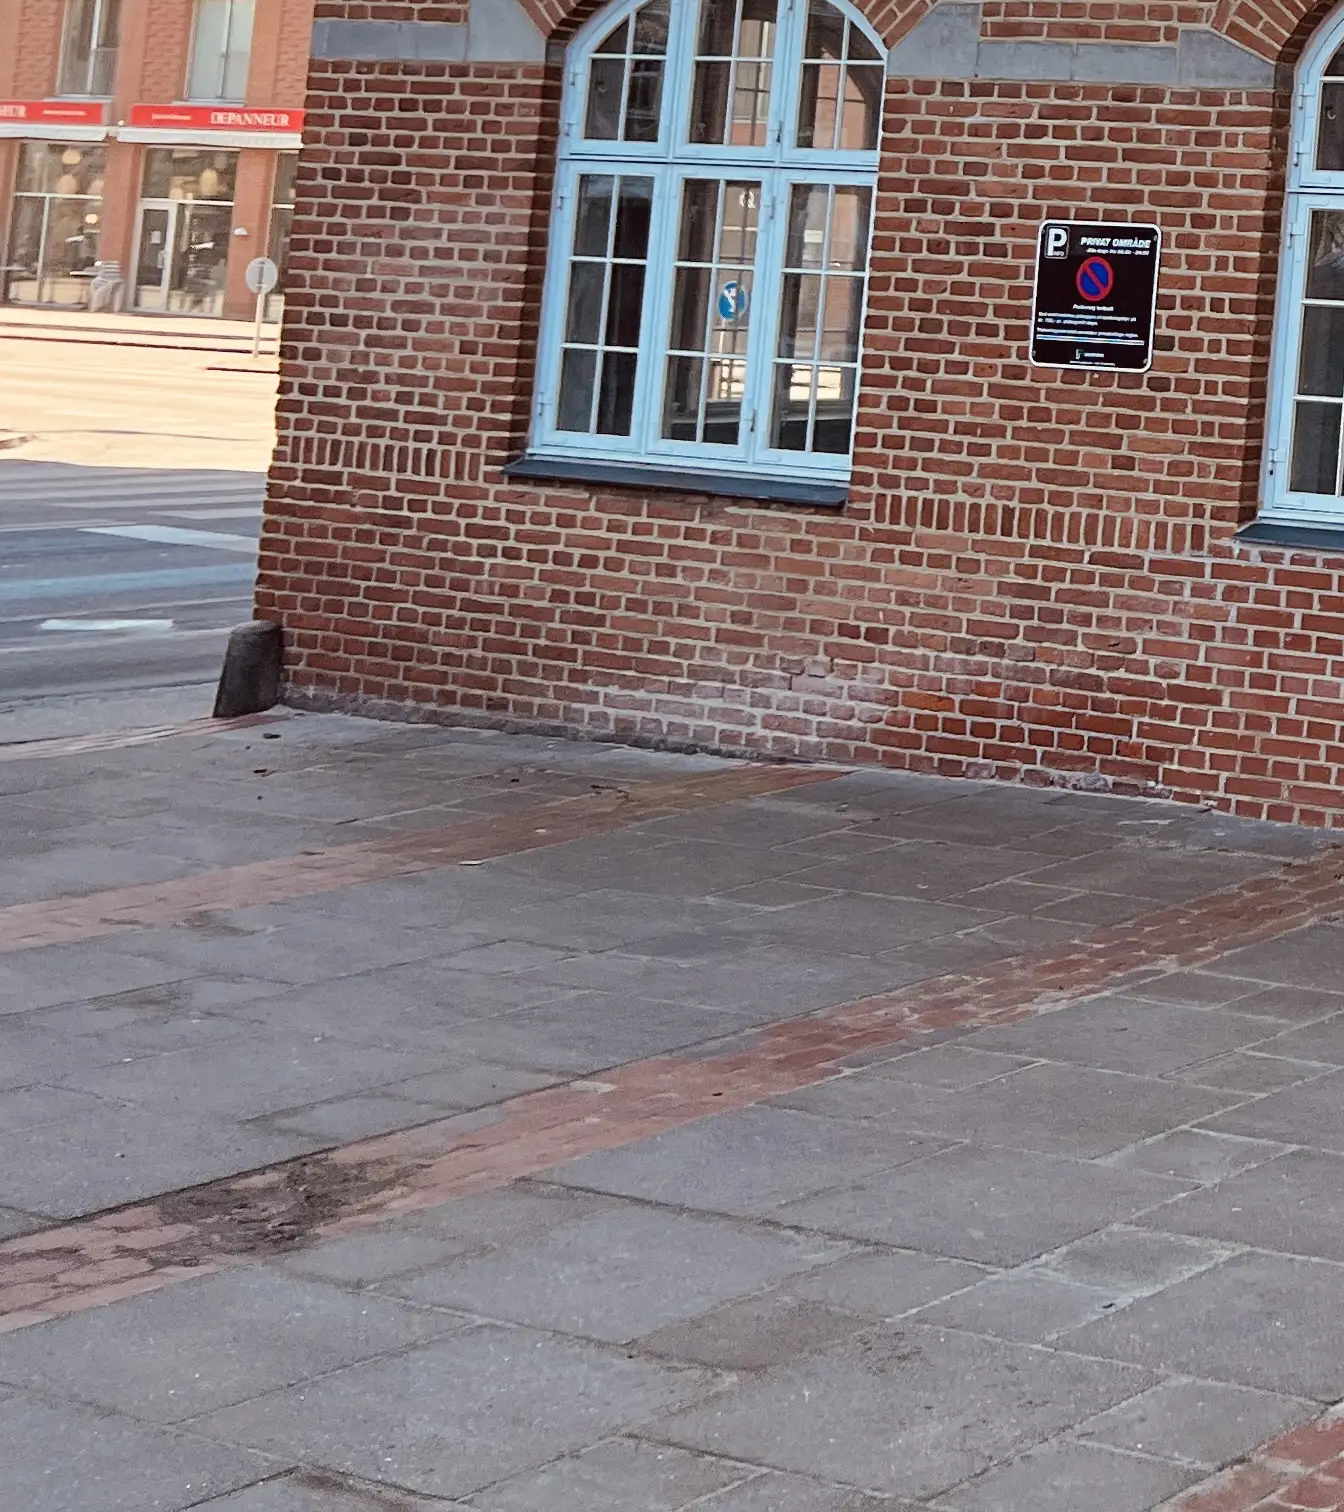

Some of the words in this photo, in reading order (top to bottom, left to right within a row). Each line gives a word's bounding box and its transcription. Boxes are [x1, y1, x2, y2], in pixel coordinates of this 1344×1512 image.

[210, 111, 290, 127] DEPANNEUR
[1047, 227, 1068, 257] P
[1080, 236, 1111, 247] PRIVAT
